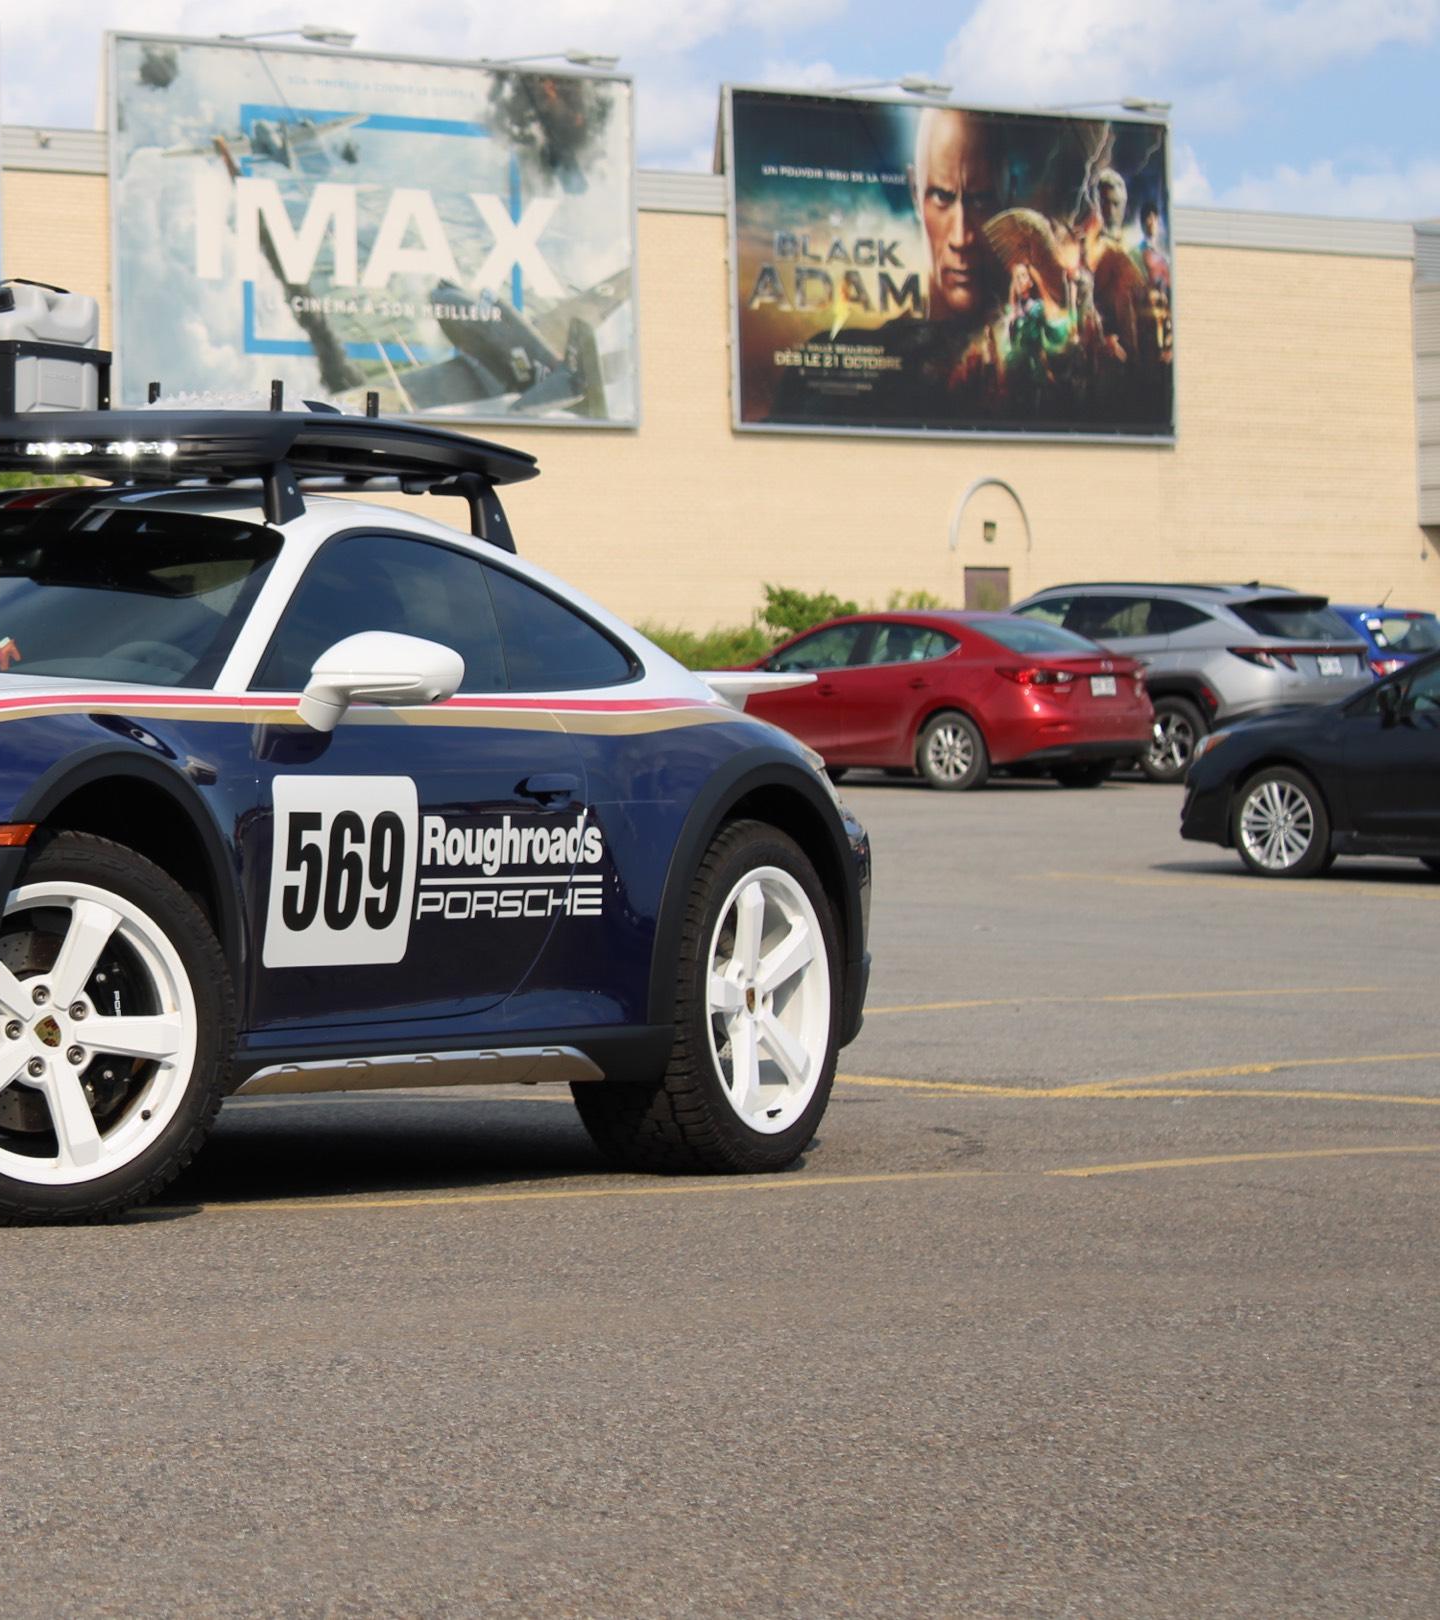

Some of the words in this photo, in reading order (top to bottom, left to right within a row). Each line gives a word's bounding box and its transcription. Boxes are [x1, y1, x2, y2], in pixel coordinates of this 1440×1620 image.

[195, 174, 563, 298] IMAX
[774, 230, 906, 269] BLACK
[424, 303, 503, 322] MEILLEUR
[749, 264, 924, 318] ADAM
[804, 353, 821, 368] LE
[823, 353, 839, 369] 21
[422, 815, 603, 876] Roughroads
[282, 810, 406, 932] 569
[416, 888, 603, 920] PORSCHE
